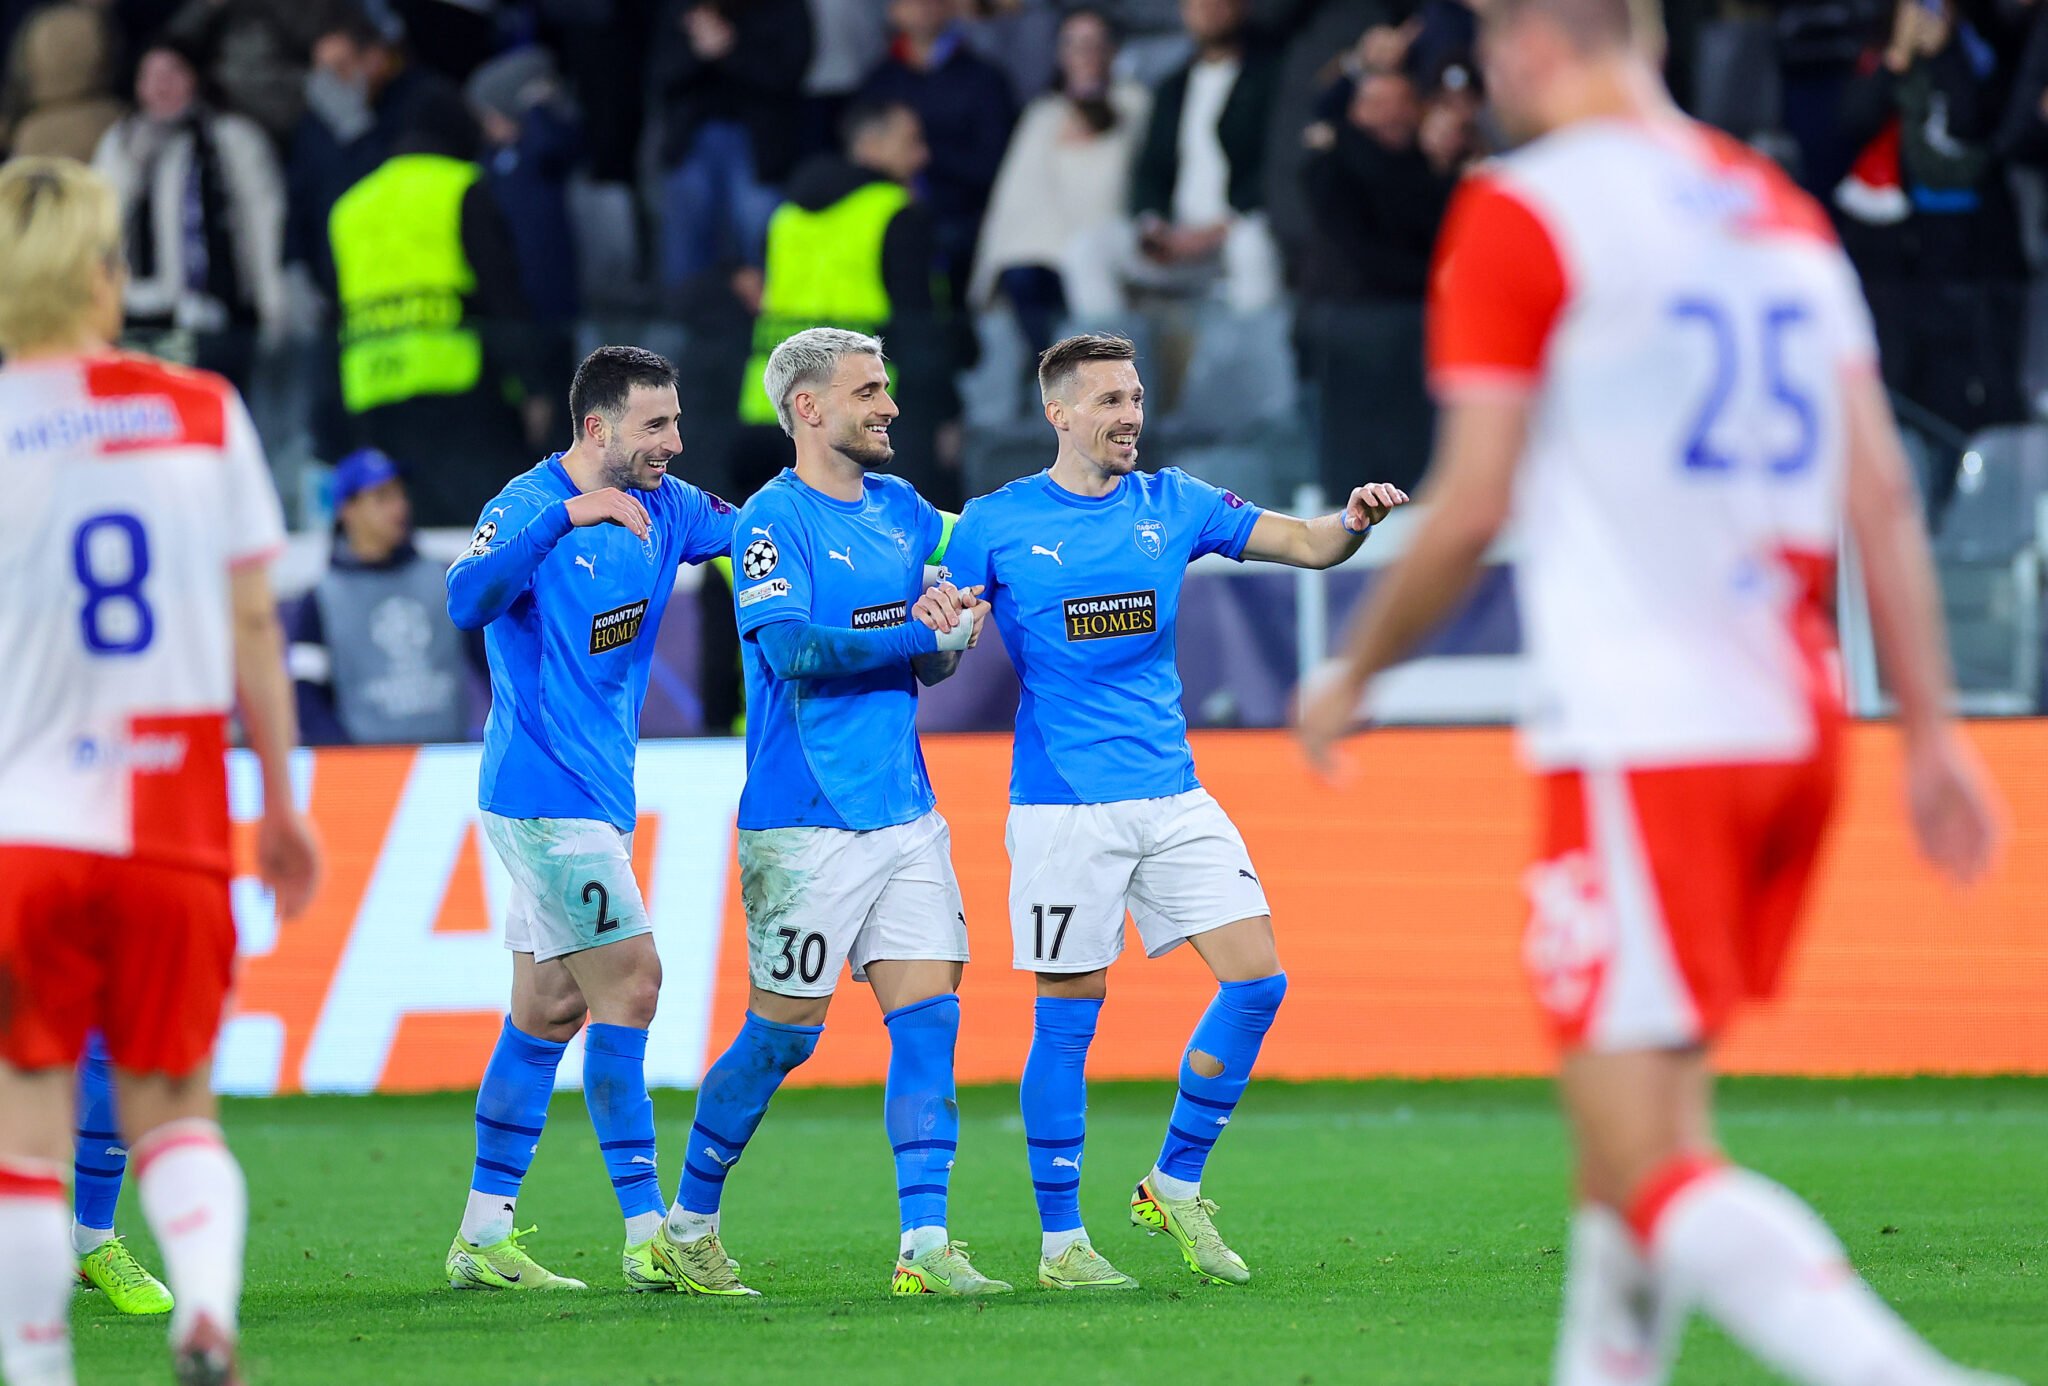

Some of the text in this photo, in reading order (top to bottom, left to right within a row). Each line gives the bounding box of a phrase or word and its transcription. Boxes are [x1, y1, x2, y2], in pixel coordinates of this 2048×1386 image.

[1668, 300, 1820, 474] 25
[74, 513, 153, 656] 8
[1068, 596, 1153, 615] KORANTINA
[1071, 609, 1153, 636] HOMES
[581, 880, 620, 936] 2
[1030, 903, 1077, 961] 17
[770, 926, 827, 985] 30
